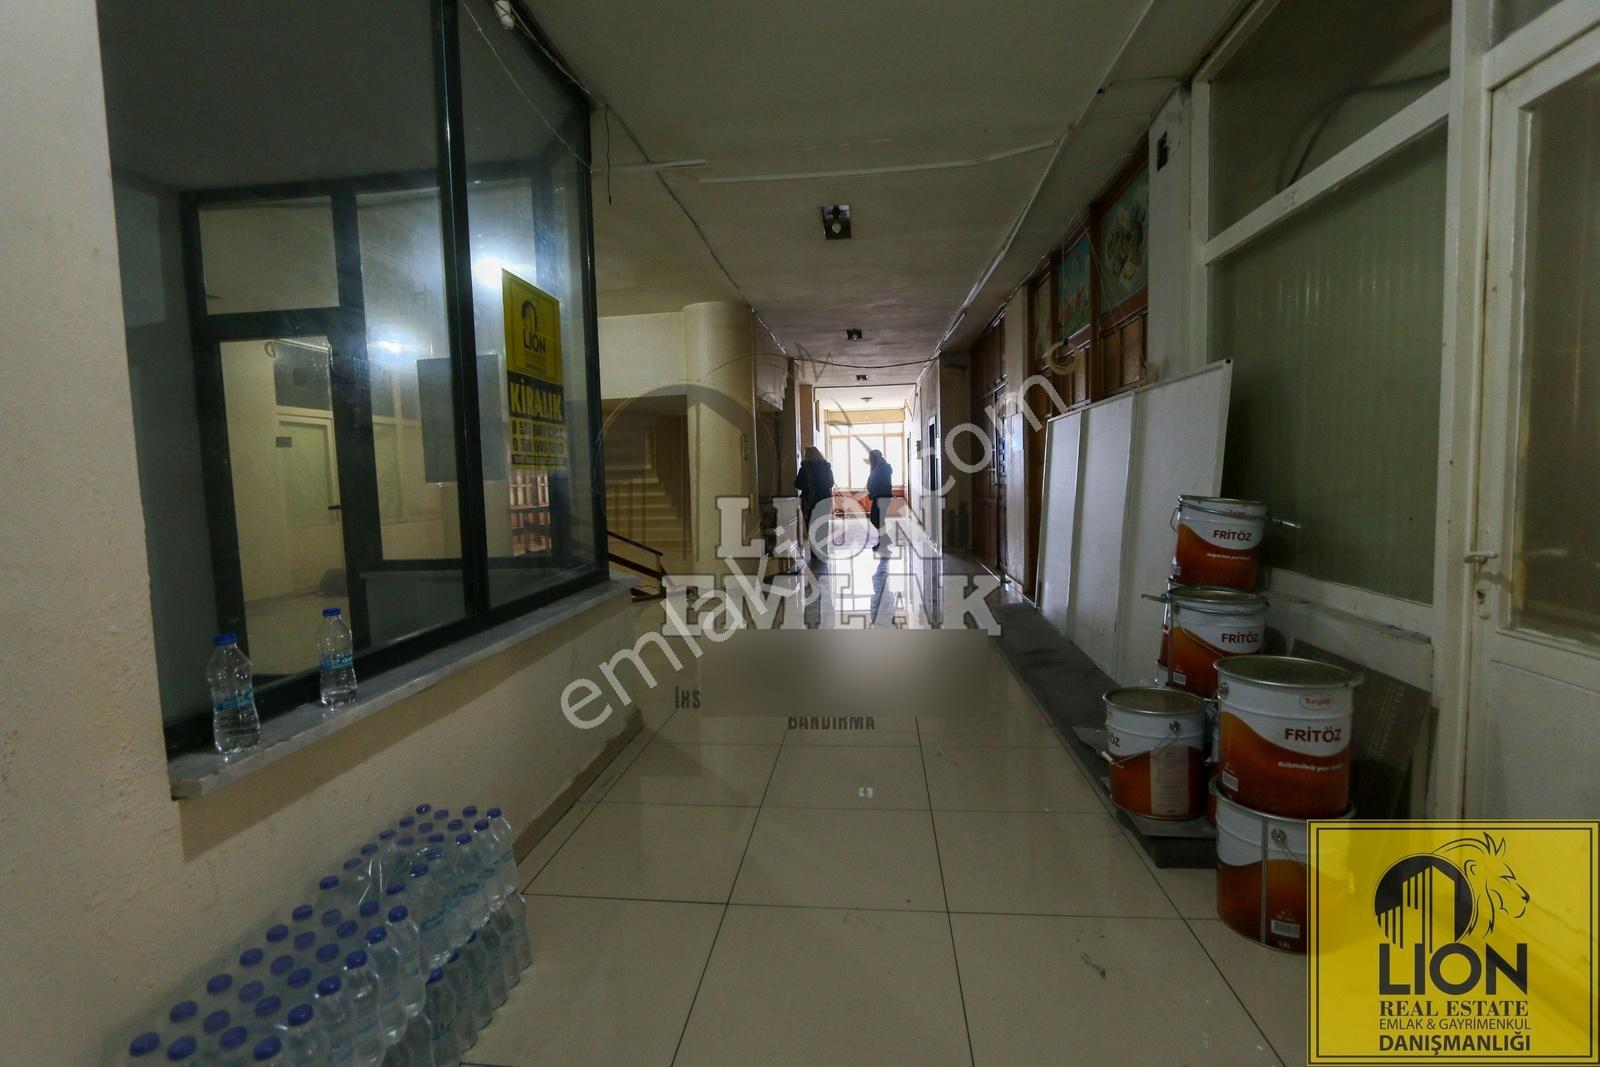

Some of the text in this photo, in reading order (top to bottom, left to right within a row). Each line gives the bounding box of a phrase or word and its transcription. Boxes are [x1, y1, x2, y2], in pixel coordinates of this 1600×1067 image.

[523, 331, 546, 354] LION
[511, 379, 562, 421] KİRALIK
[1213, 528, 1252, 541] FRİTÖZ
[1221, 631, 1258, 644] FRİTÖZ
[1284, 726, 1342, 743] FRİTÖZ
